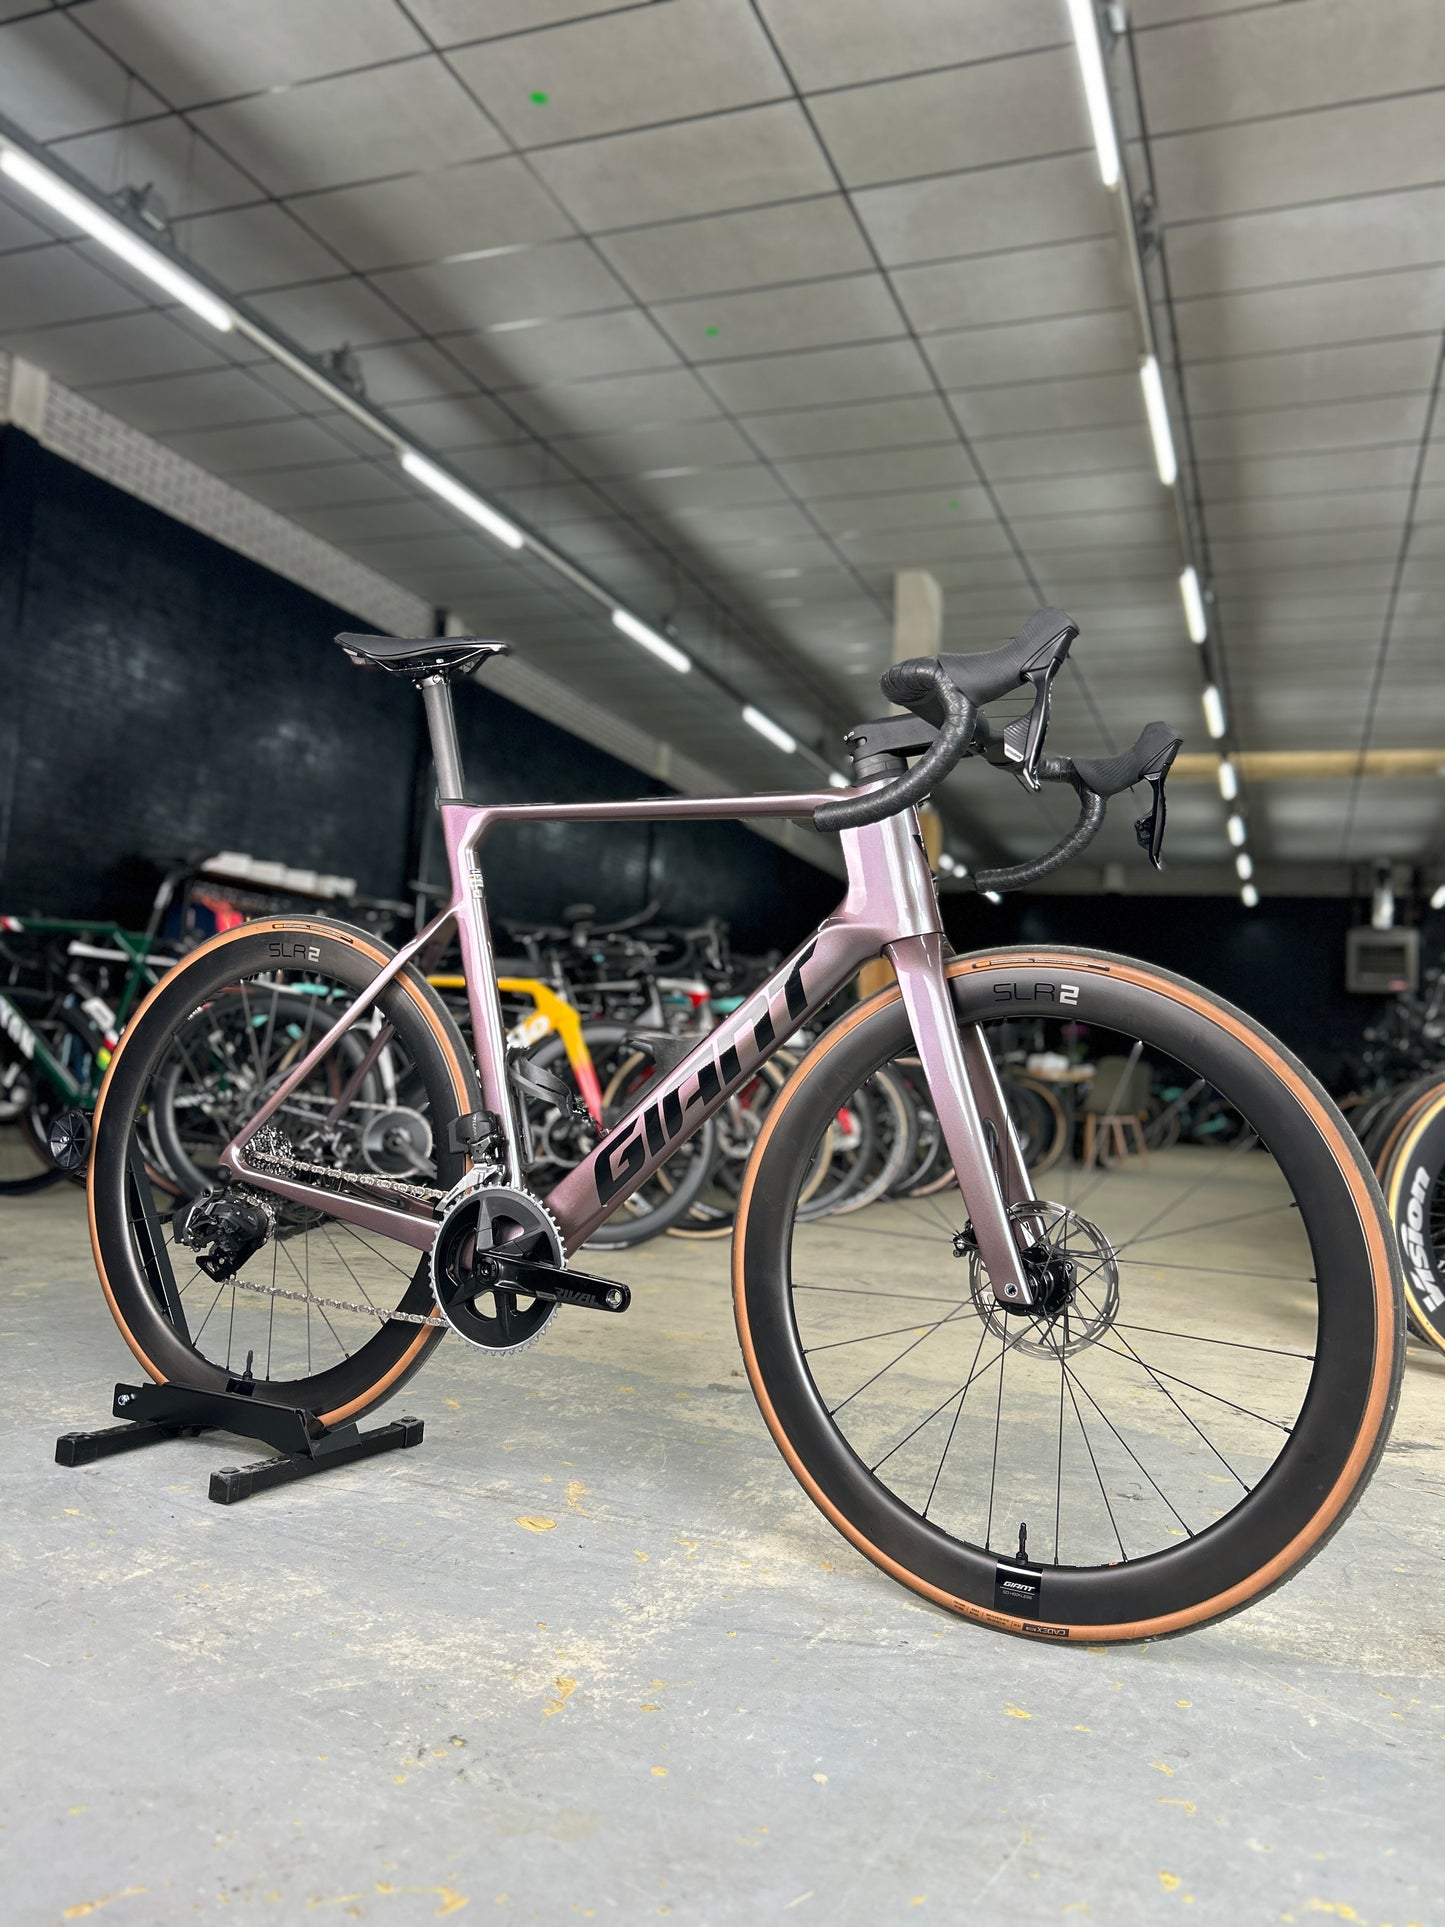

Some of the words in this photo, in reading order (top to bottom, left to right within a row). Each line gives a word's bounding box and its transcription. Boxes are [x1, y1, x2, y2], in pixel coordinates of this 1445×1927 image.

[594, 935, 819, 1206] GIANT
[554, 1287, 599, 1304] RIVAL
[1003, 1581, 1035, 1592] GIANT
